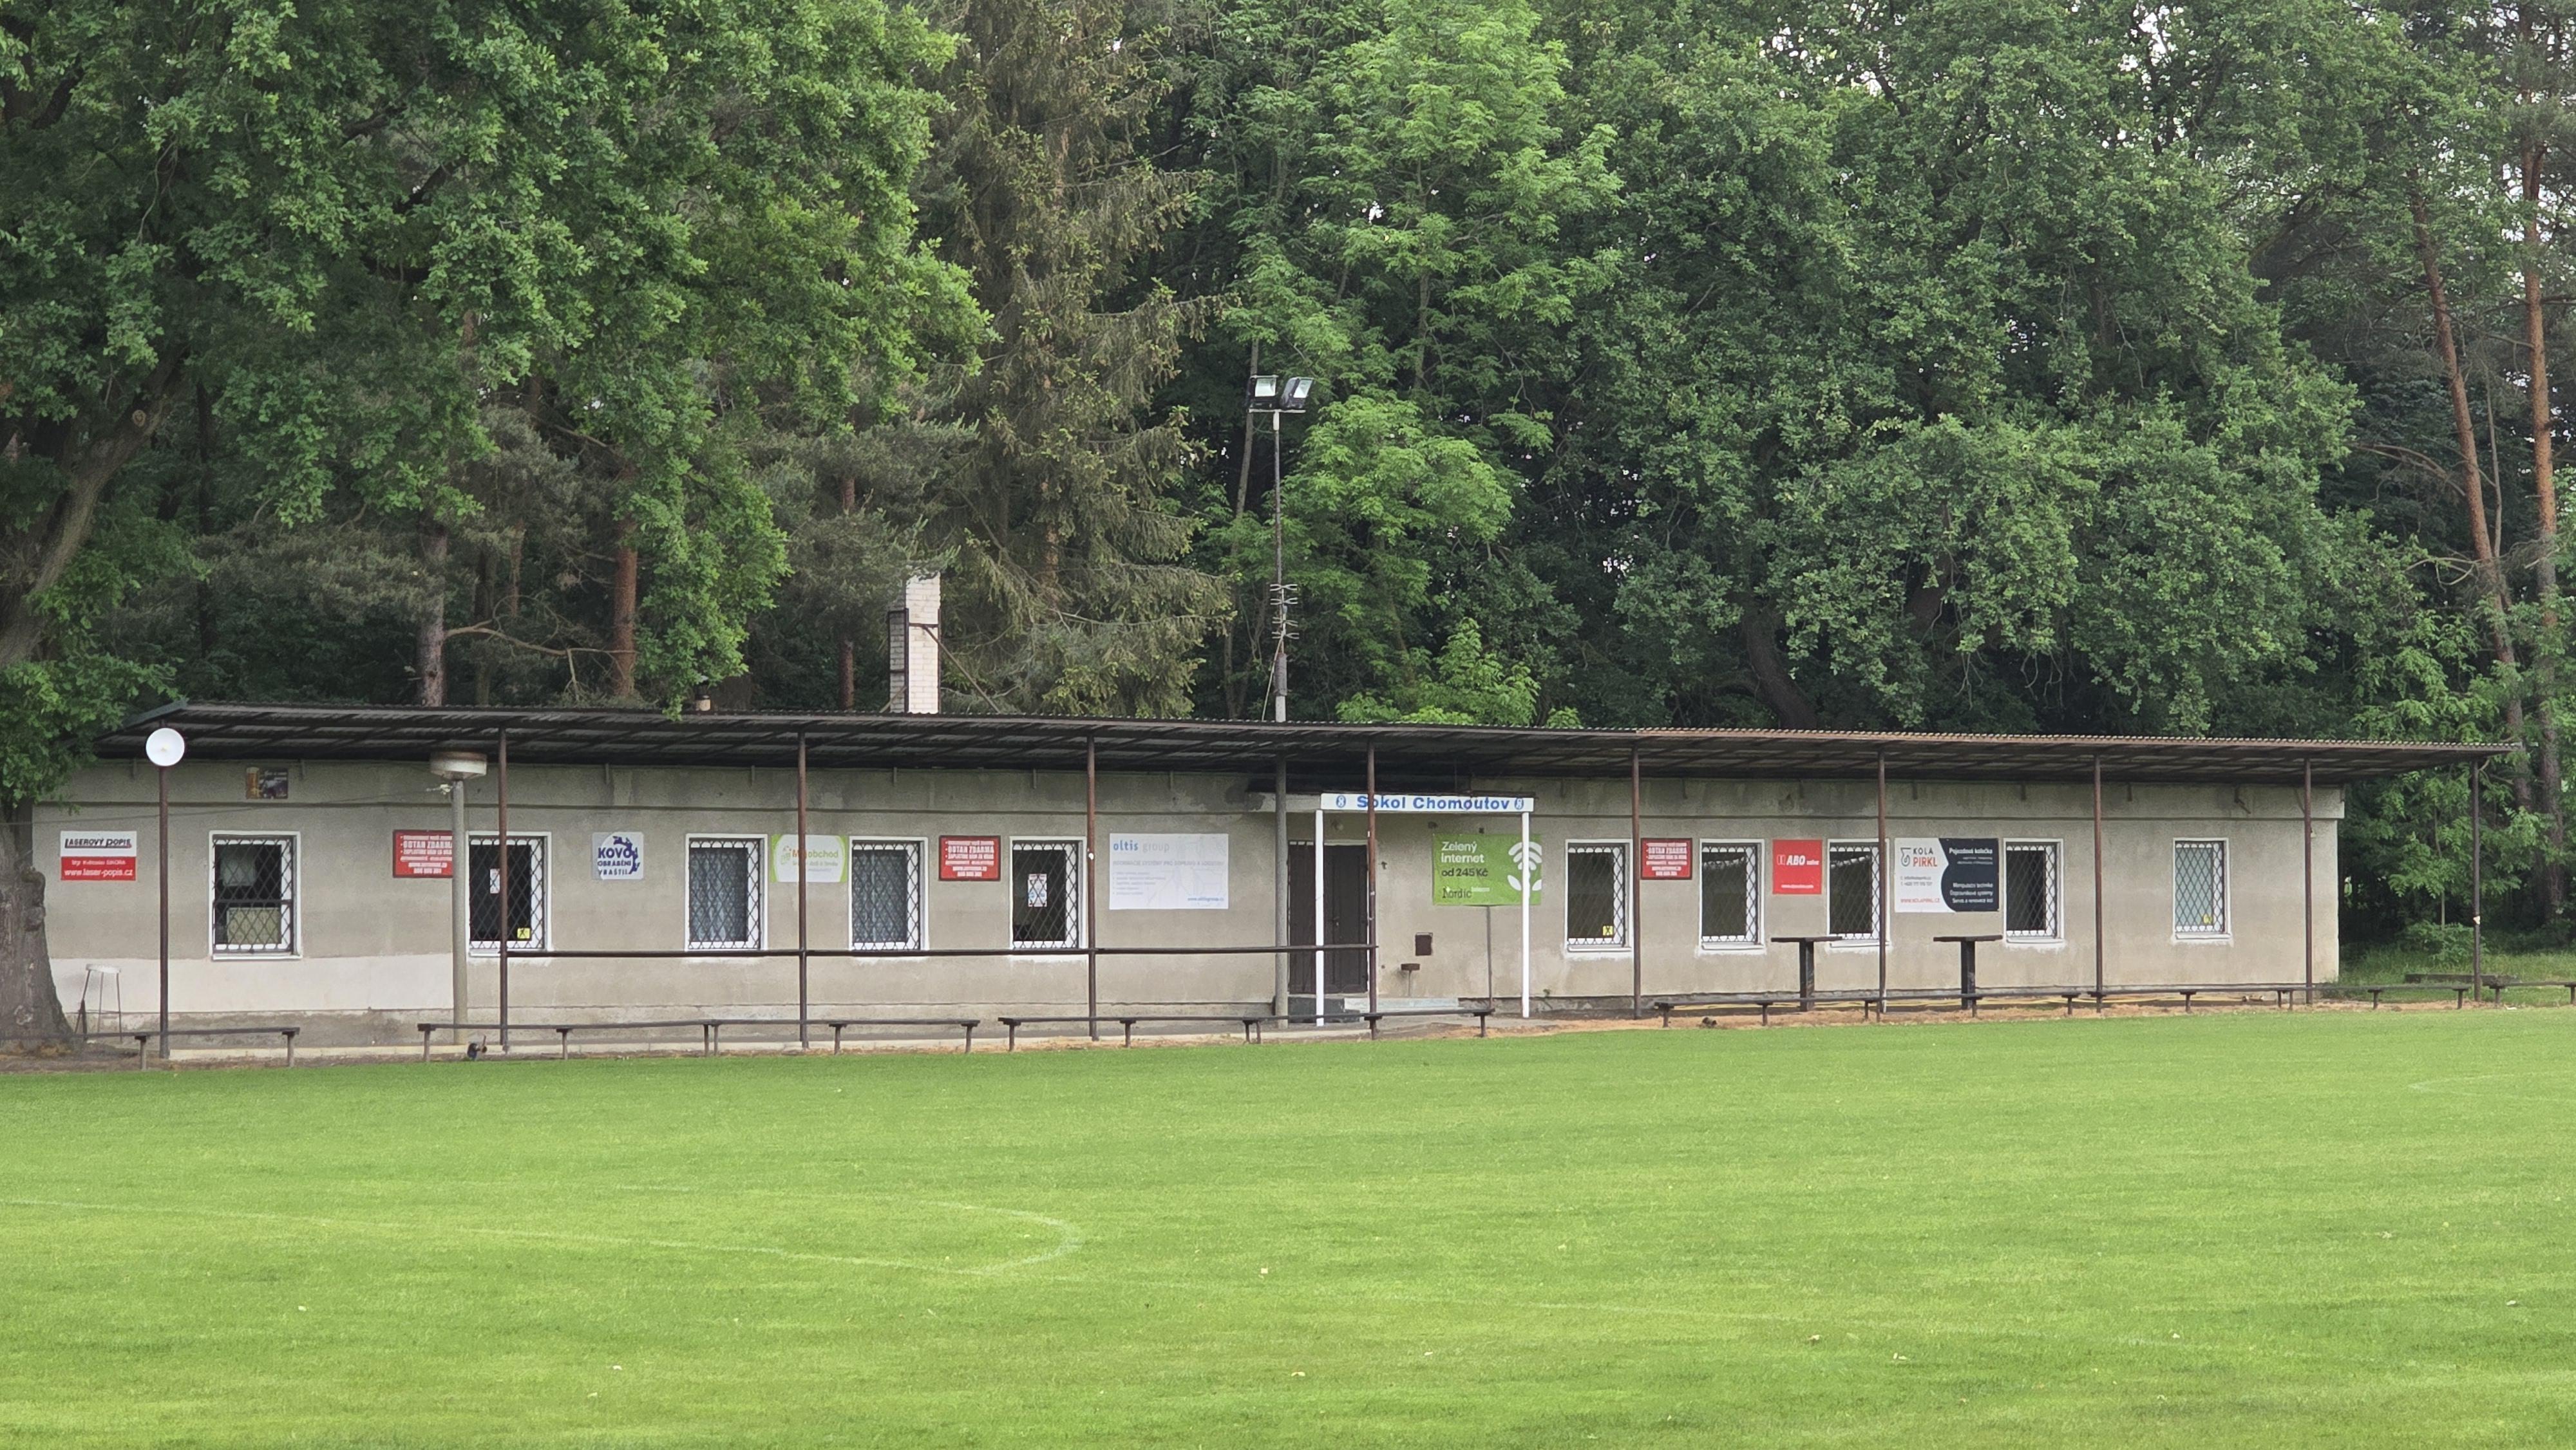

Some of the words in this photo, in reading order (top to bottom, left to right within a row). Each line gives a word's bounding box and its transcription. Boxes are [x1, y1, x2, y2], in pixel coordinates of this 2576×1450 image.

[1357, 795, 1406, 809] Sokol
[1413, 796, 1510, 810] Chomoutov
[64, 838, 104, 849] LASEROVÝ
[106, 838, 132, 849] POPIS
[1113, 840, 1139, 851] oltis
[1142, 843, 1170, 853] group
[1441, 841, 1477, 853] Zelený
[598, 847, 631, 858] KOVO
[1786, 854, 1806, 865] ABO
[1913, 857, 1938, 867] PIRKL
[64, 868, 133, 878] www.laser-popis.cz
[1441, 868, 1454, 876] od
[1455, 868, 1475, 876] 245
[1476, 867, 1488, 876] Kč
[1443, 887, 1472, 898] Nordic
